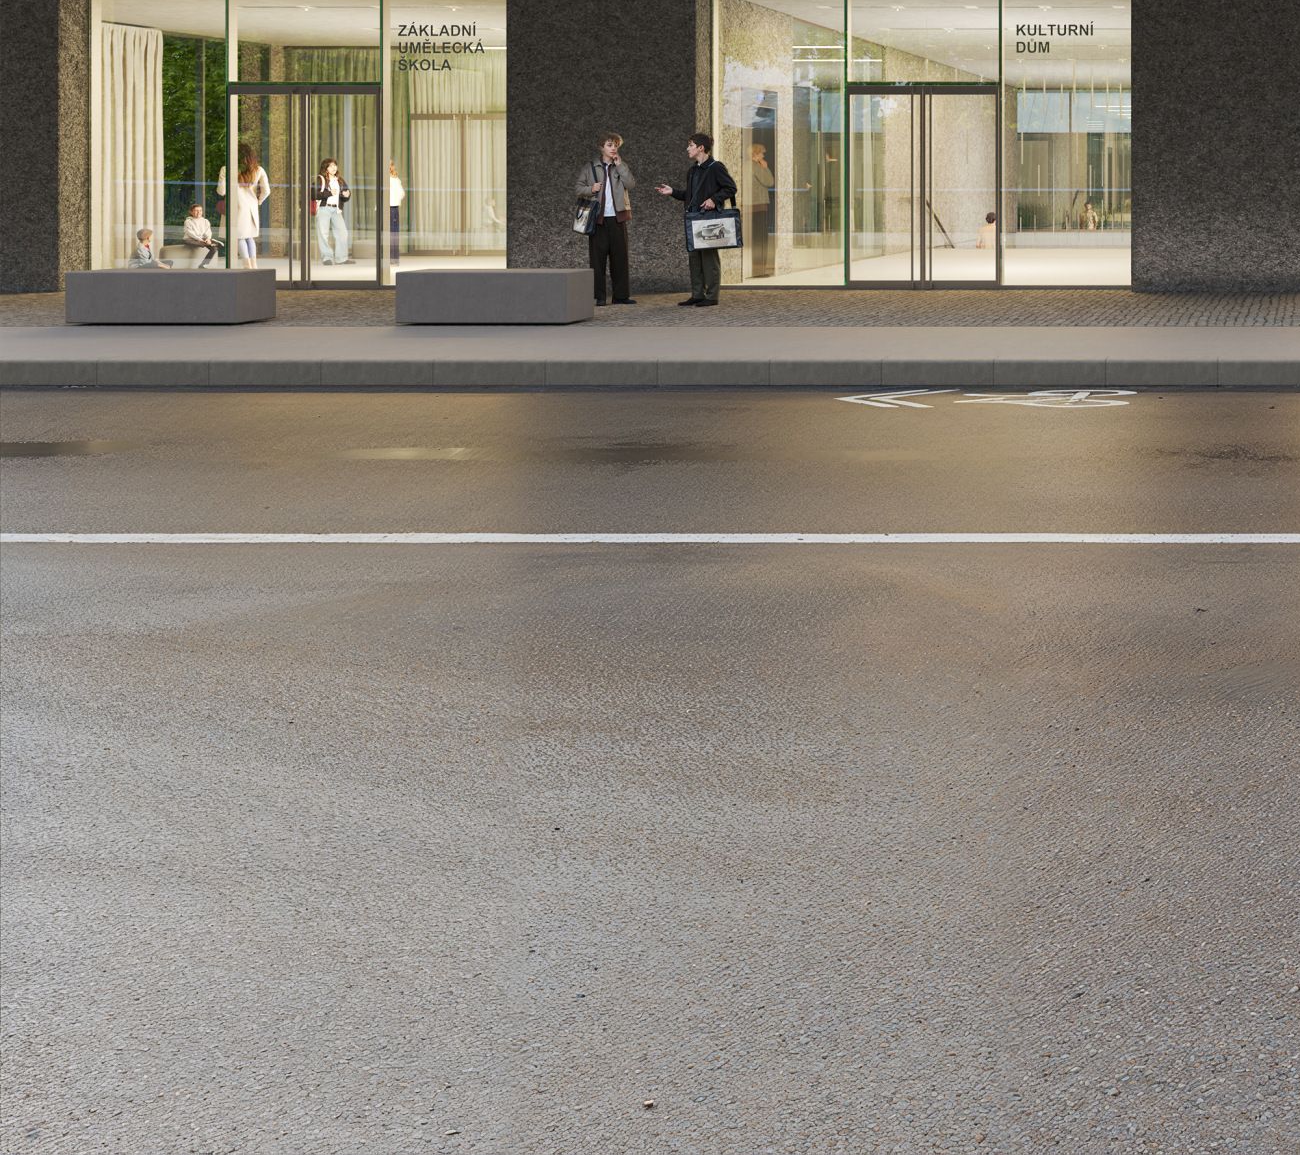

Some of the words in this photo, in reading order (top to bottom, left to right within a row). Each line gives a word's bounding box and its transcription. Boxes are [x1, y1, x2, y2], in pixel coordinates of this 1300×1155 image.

[397, 21, 476, 37] ZÁKLADNÍ
[1015, 20, 1094, 36] KULTURNÍ
[398, 38, 485, 54] UMĚLECKÁ
[1015, 38, 1050, 54] DŮM
[397, 55, 452, 71] ŠKOLA
